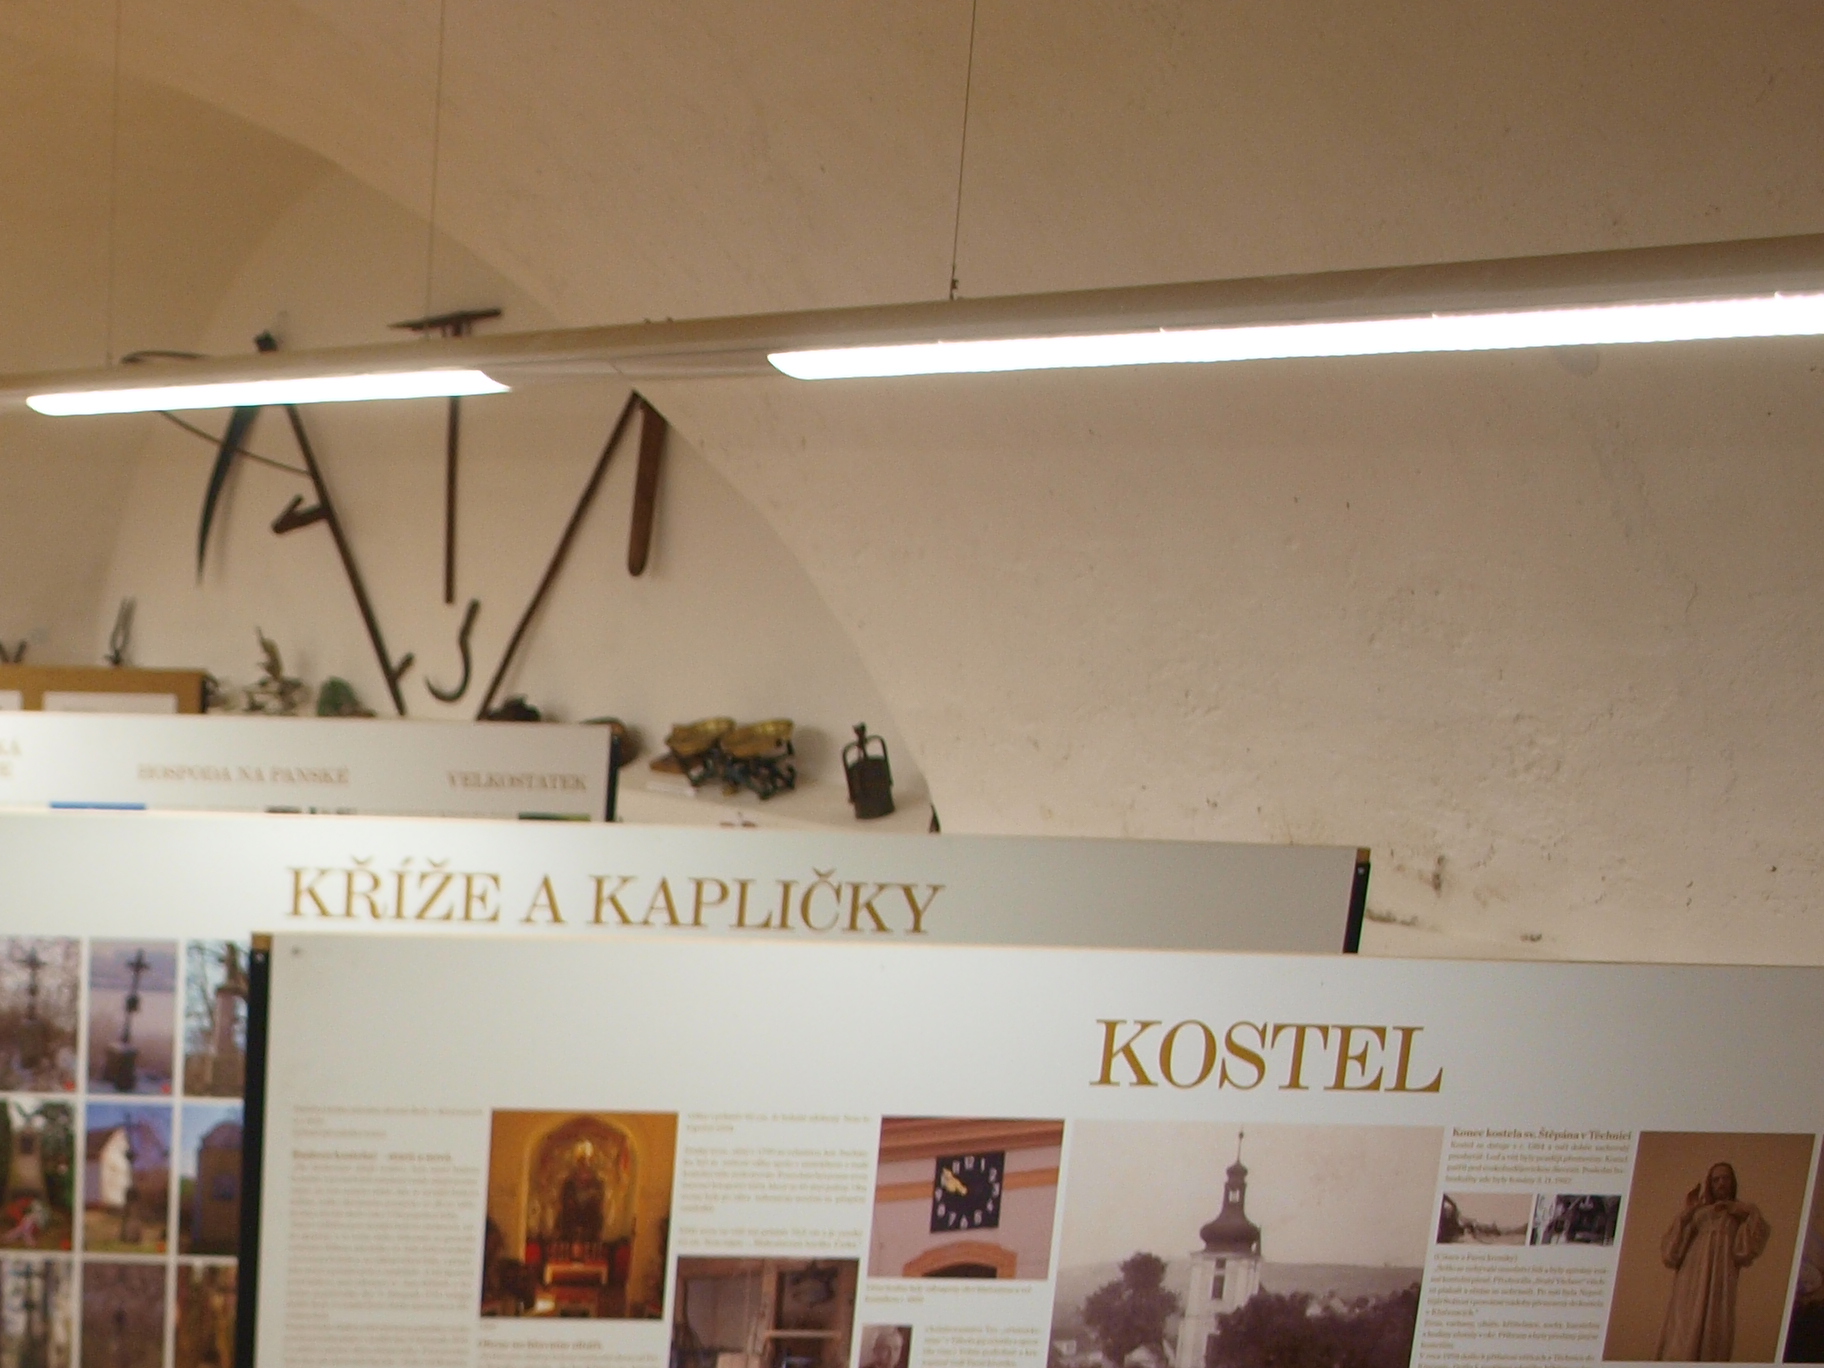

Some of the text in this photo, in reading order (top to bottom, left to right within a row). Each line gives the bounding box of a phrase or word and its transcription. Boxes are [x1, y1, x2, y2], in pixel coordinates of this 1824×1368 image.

[446, 768, 589, 792] VELKOSTATEK
[286, 855, 948, 934] KŘÍŽE A KAPLIČKY
[1088, 1018, 1444, 1093] KOSTEL
